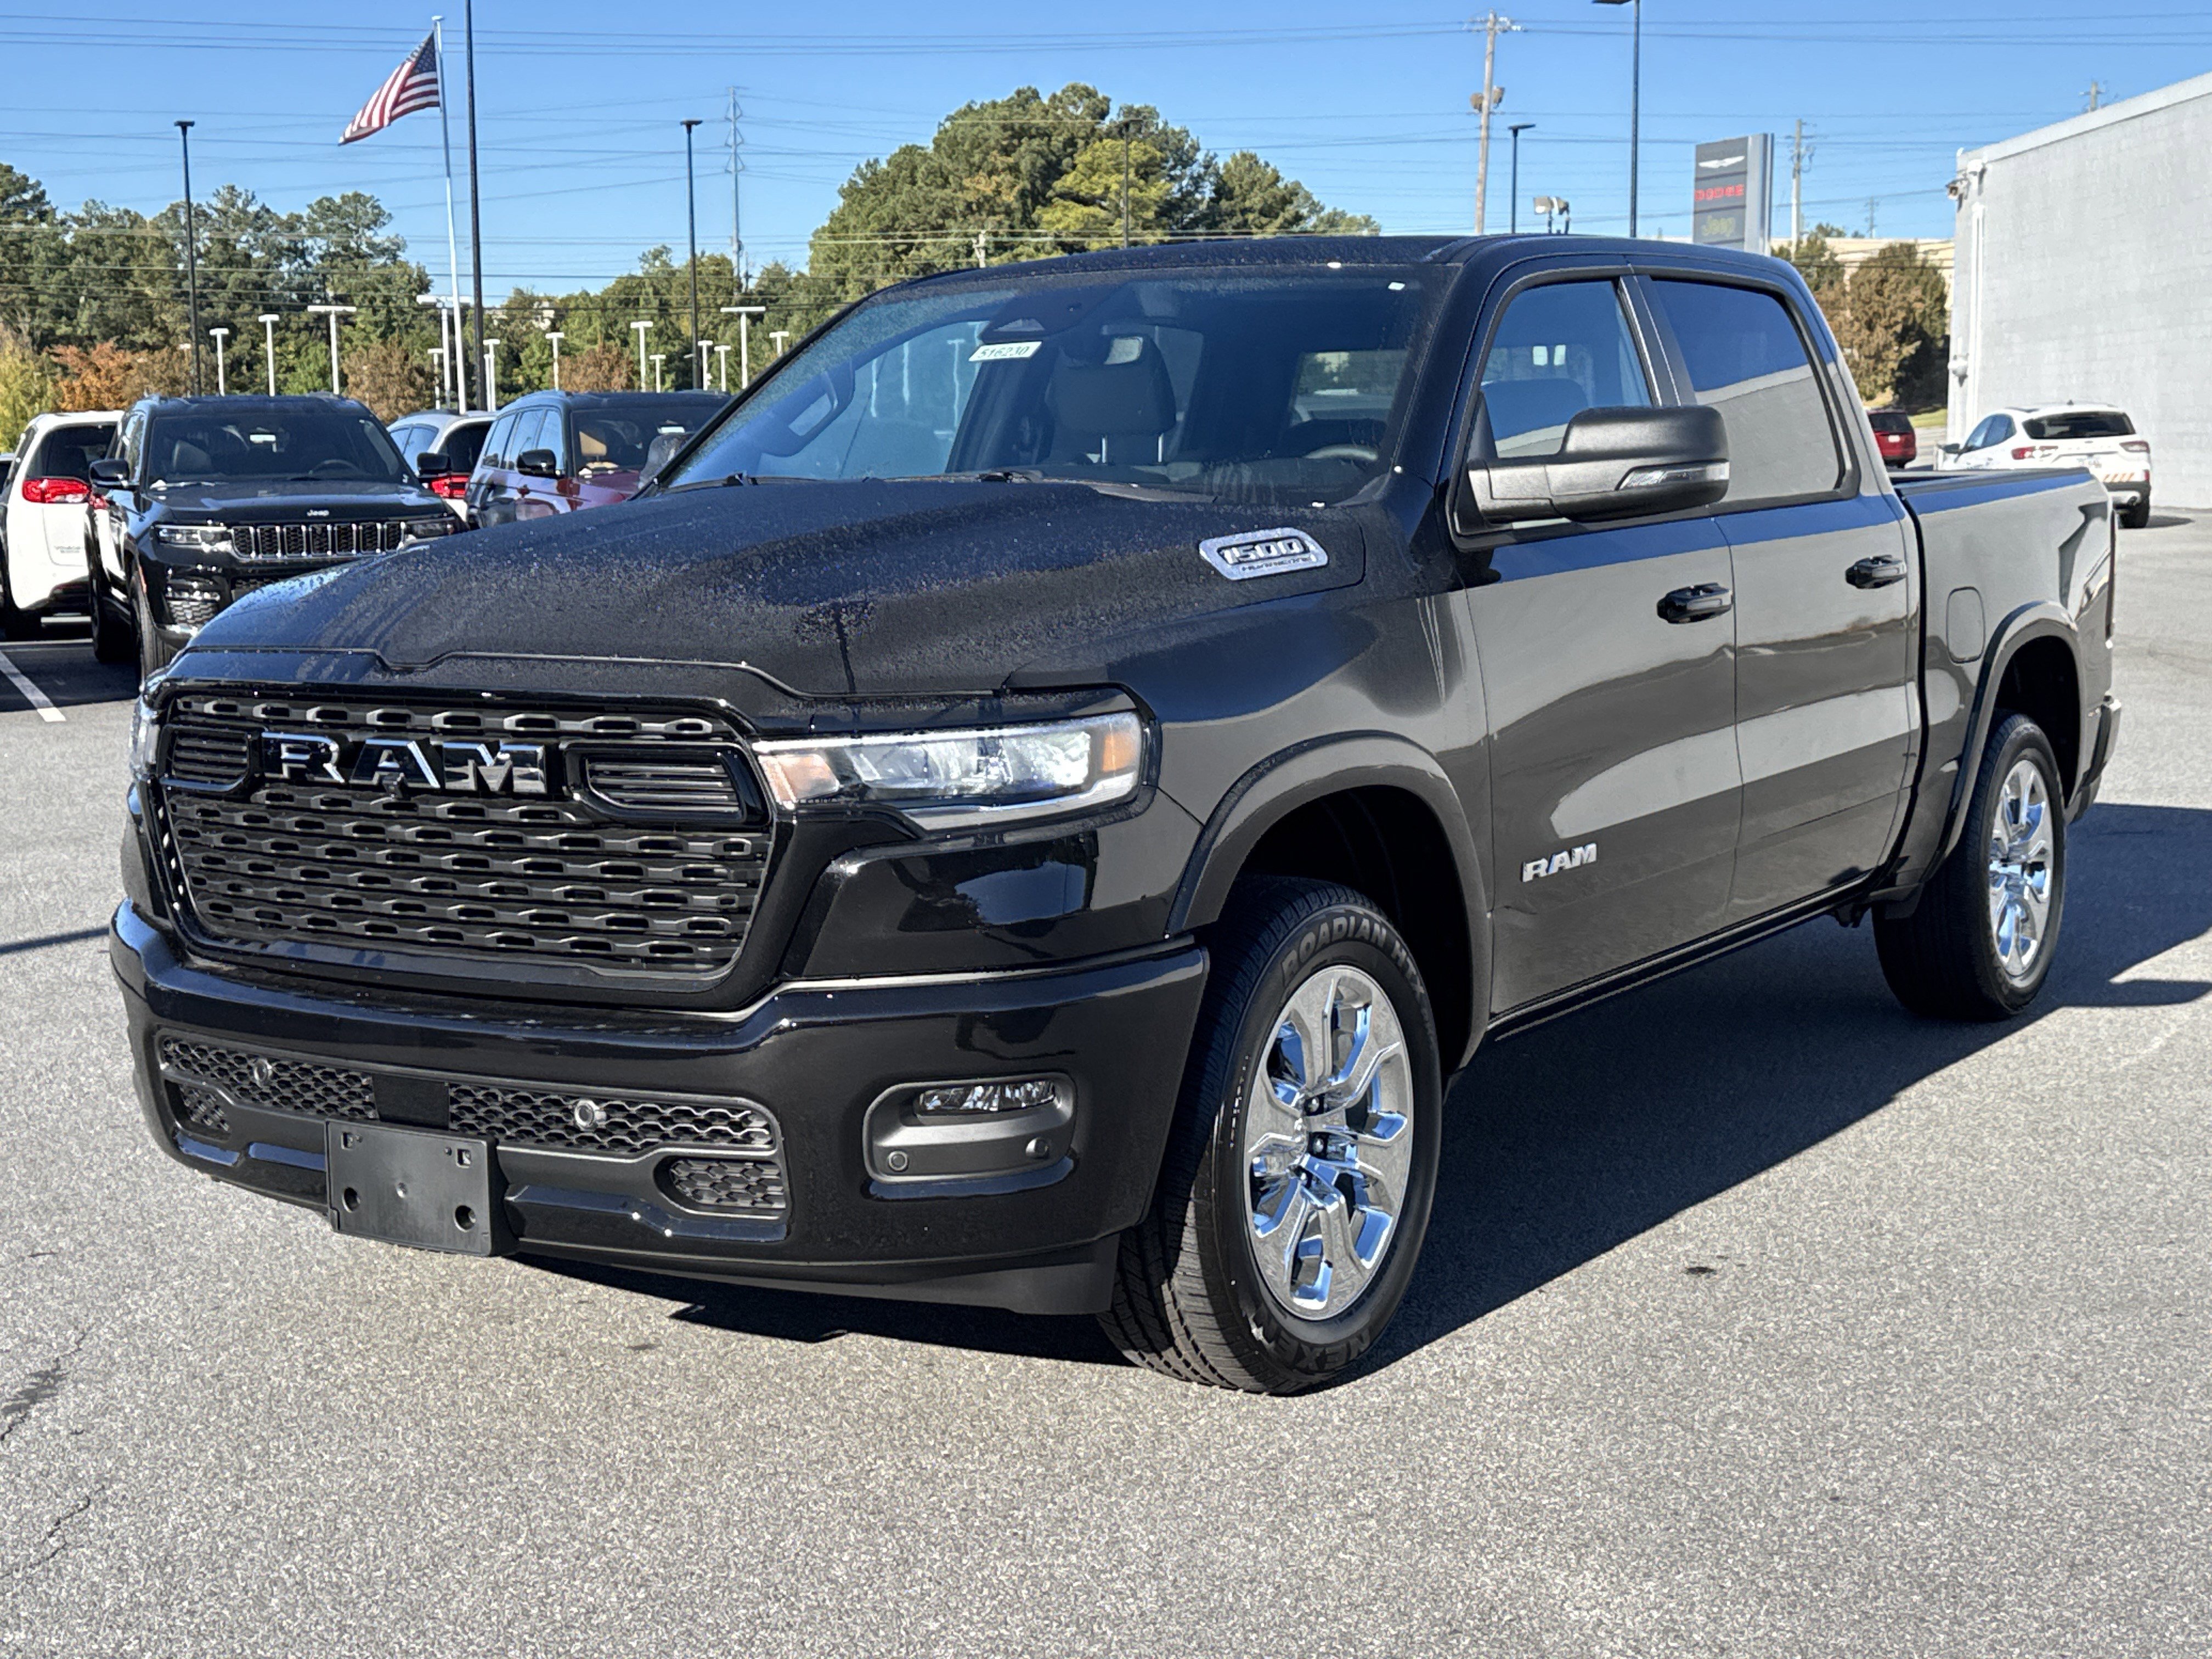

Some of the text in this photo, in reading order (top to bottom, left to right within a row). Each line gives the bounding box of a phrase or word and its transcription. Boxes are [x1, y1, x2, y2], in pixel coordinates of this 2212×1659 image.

[1695, 183, 1745, 201] DODGE
[1702, 215, 1735, 237] Jeep
[1219, 538, 1306, 565] 1500
[261, 731, 548, 794] RAM
[1522, 843, 1597, 882] RAM
[1281, 915, 1386, 986] ROADIAN
